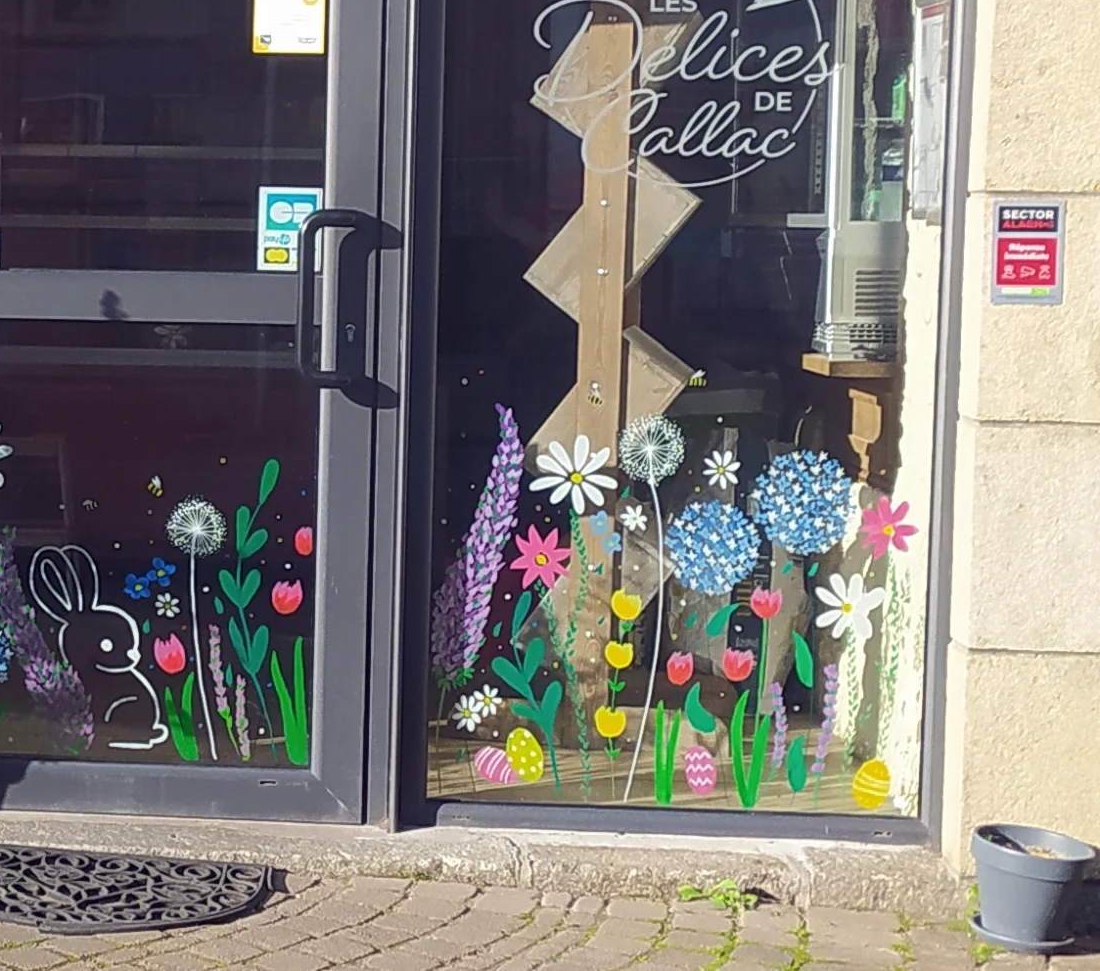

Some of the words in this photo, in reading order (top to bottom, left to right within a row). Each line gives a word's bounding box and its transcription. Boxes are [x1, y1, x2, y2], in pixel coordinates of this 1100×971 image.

[754, 91, 793, 112] DE
[581, 88, 797, 173] Callac
[1002, 209, 1055, 220] SECTOR
